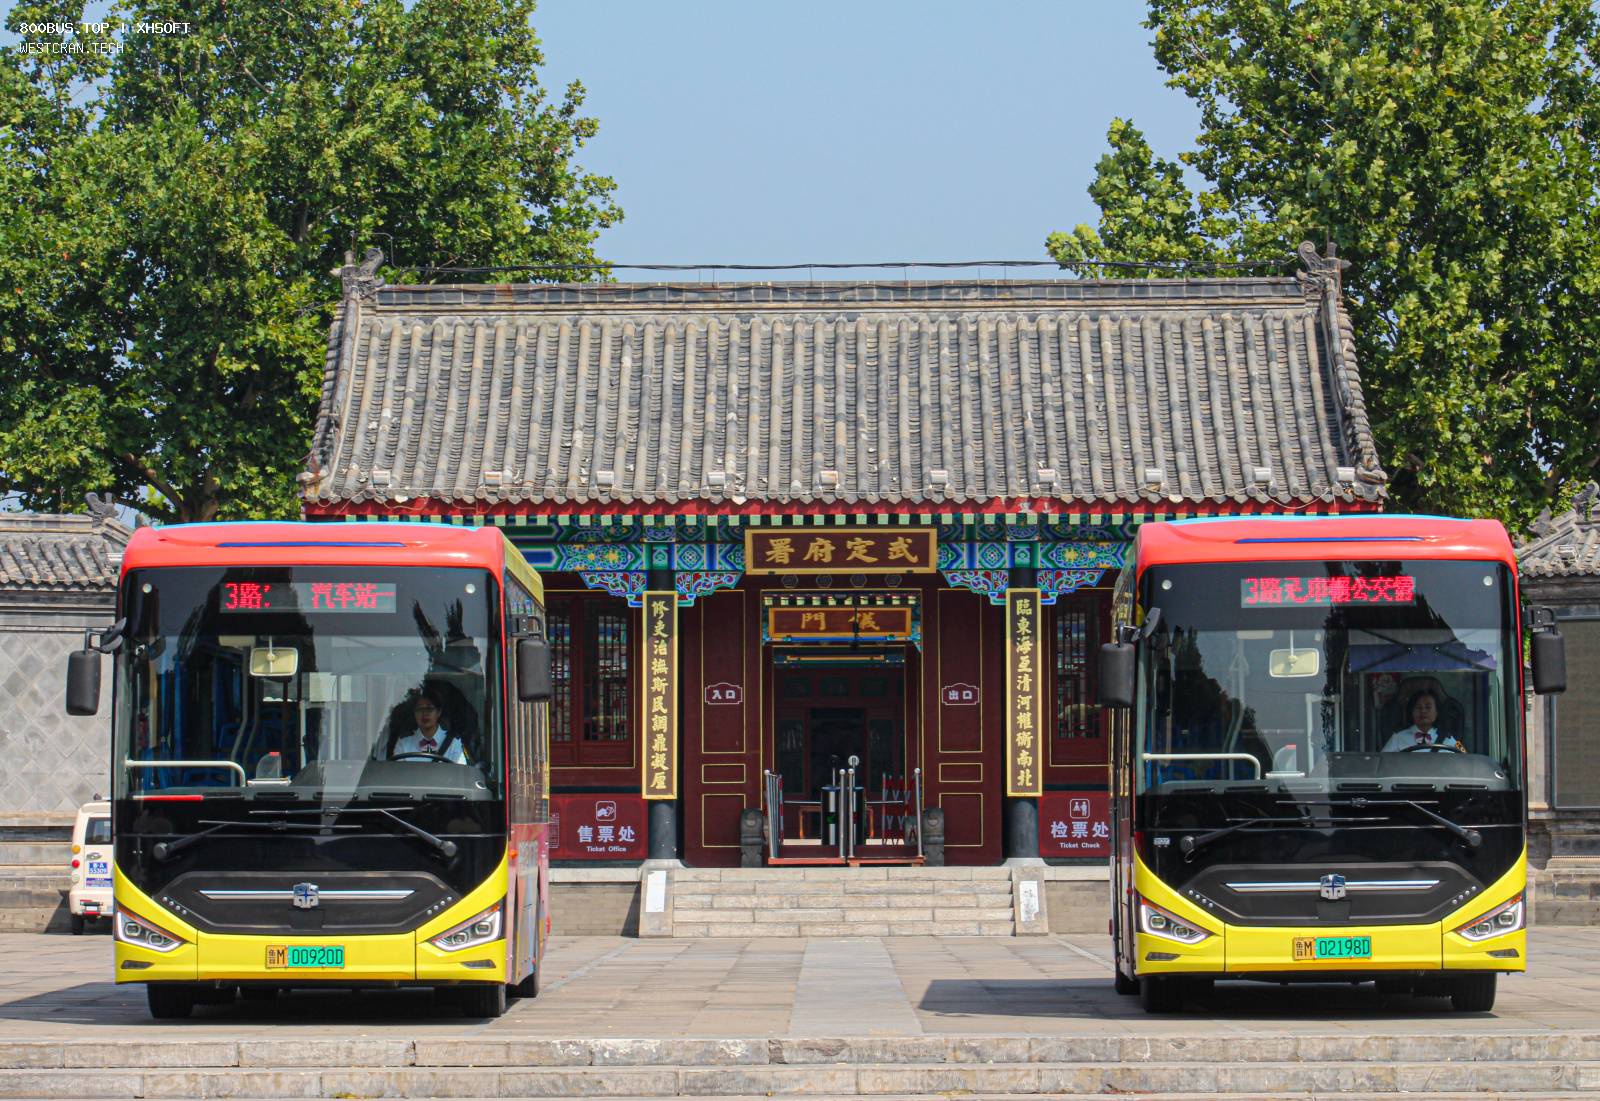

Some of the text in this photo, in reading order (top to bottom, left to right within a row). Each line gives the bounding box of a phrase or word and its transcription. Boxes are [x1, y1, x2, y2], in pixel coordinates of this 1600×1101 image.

[765, 537, 919, 565] 武定府署
[711, 689, 736, 700] 入口
[948, 690, 973, 700] 出口
[577, 825, 635, 843] 售票处
[1050, 821, 1109, 839] 检票处
[586, 845, 627, 853] Ticket Office
